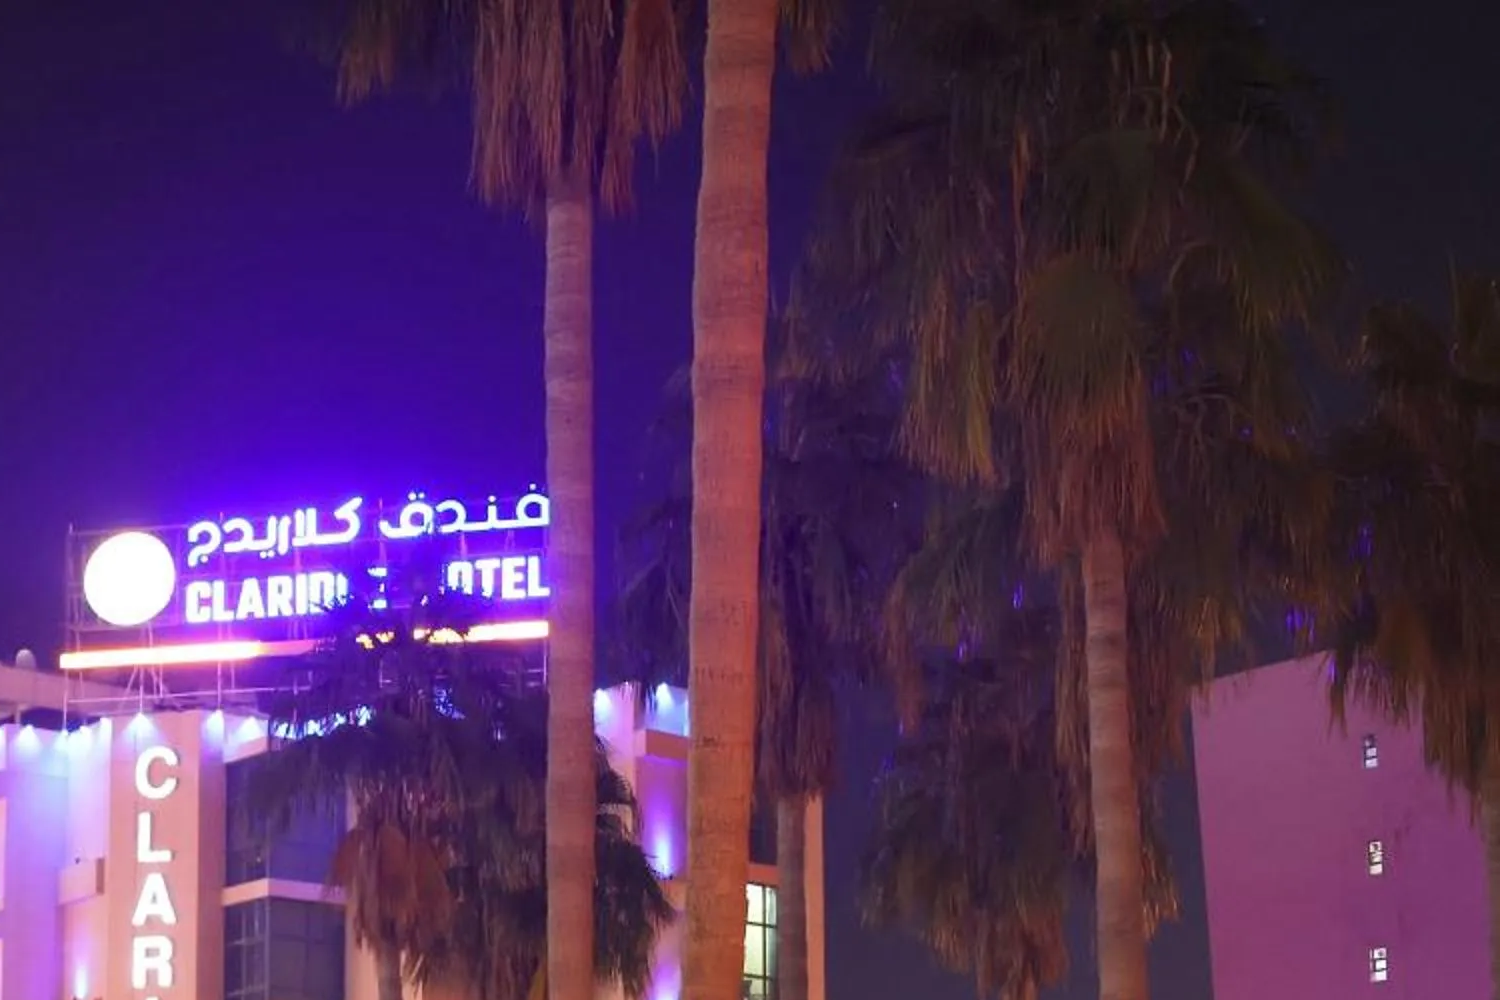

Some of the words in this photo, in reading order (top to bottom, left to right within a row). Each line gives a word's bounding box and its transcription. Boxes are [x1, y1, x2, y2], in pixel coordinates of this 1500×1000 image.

[187, 496, 363, 567] كلاريدج
[378, 483, 551, 539] فندق
[434, 555, 551, 602] OTEL
